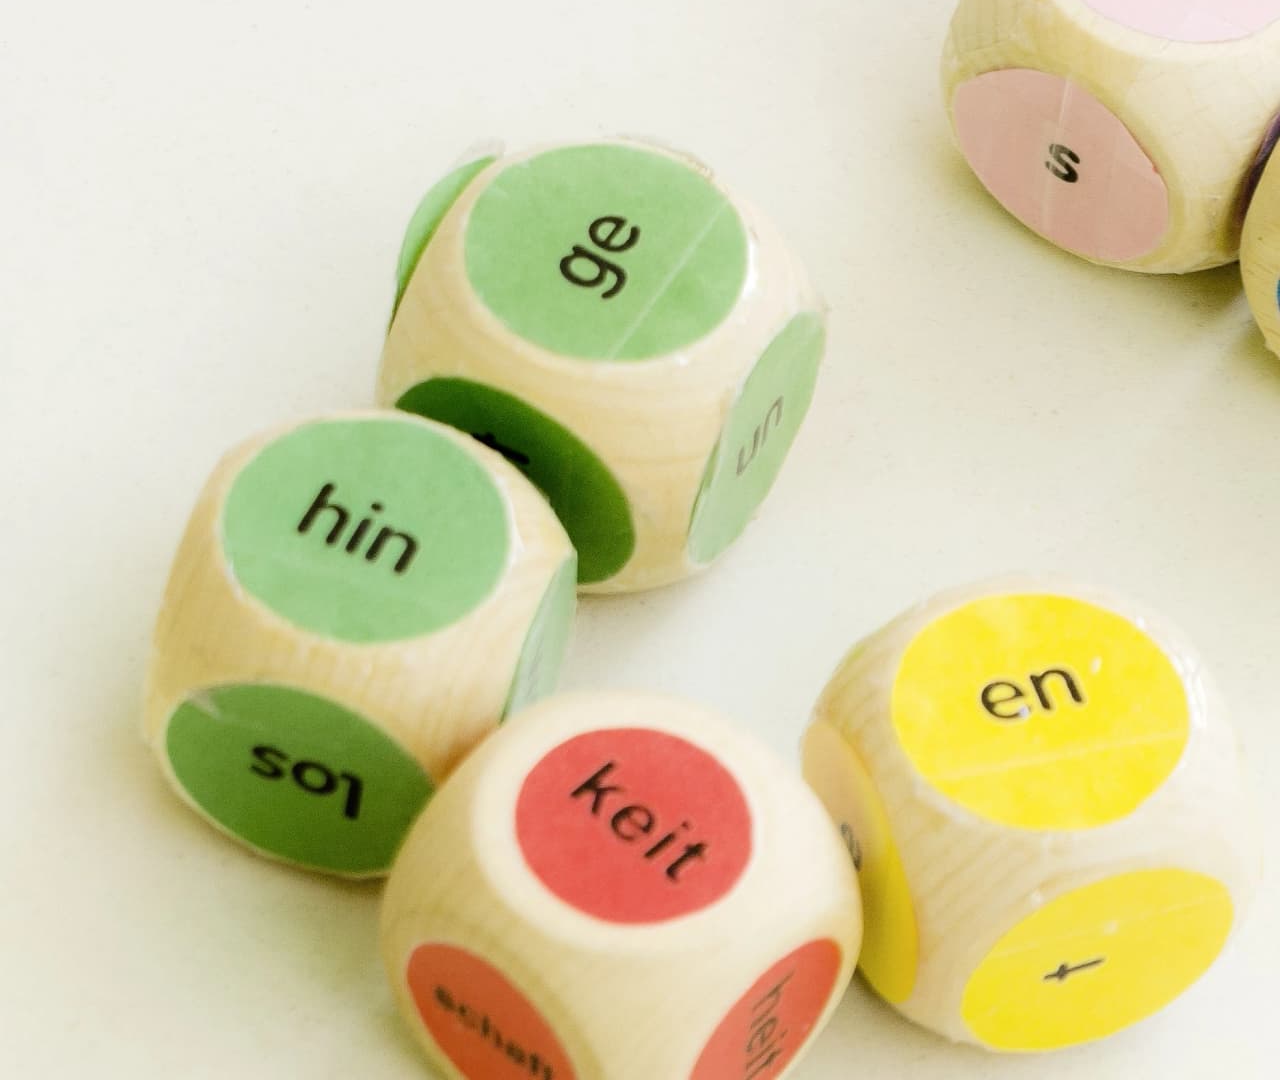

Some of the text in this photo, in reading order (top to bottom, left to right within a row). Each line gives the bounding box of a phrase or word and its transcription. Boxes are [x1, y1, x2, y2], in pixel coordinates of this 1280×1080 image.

[1044, 142, 1081, 184] s
[559, 214, 642, 299] ge
[296, 482, 420, 575] hin
[979, 664, 1086, 720] en
[249, 742, 365, 820] los
[569, 760, 710, 883] keit
